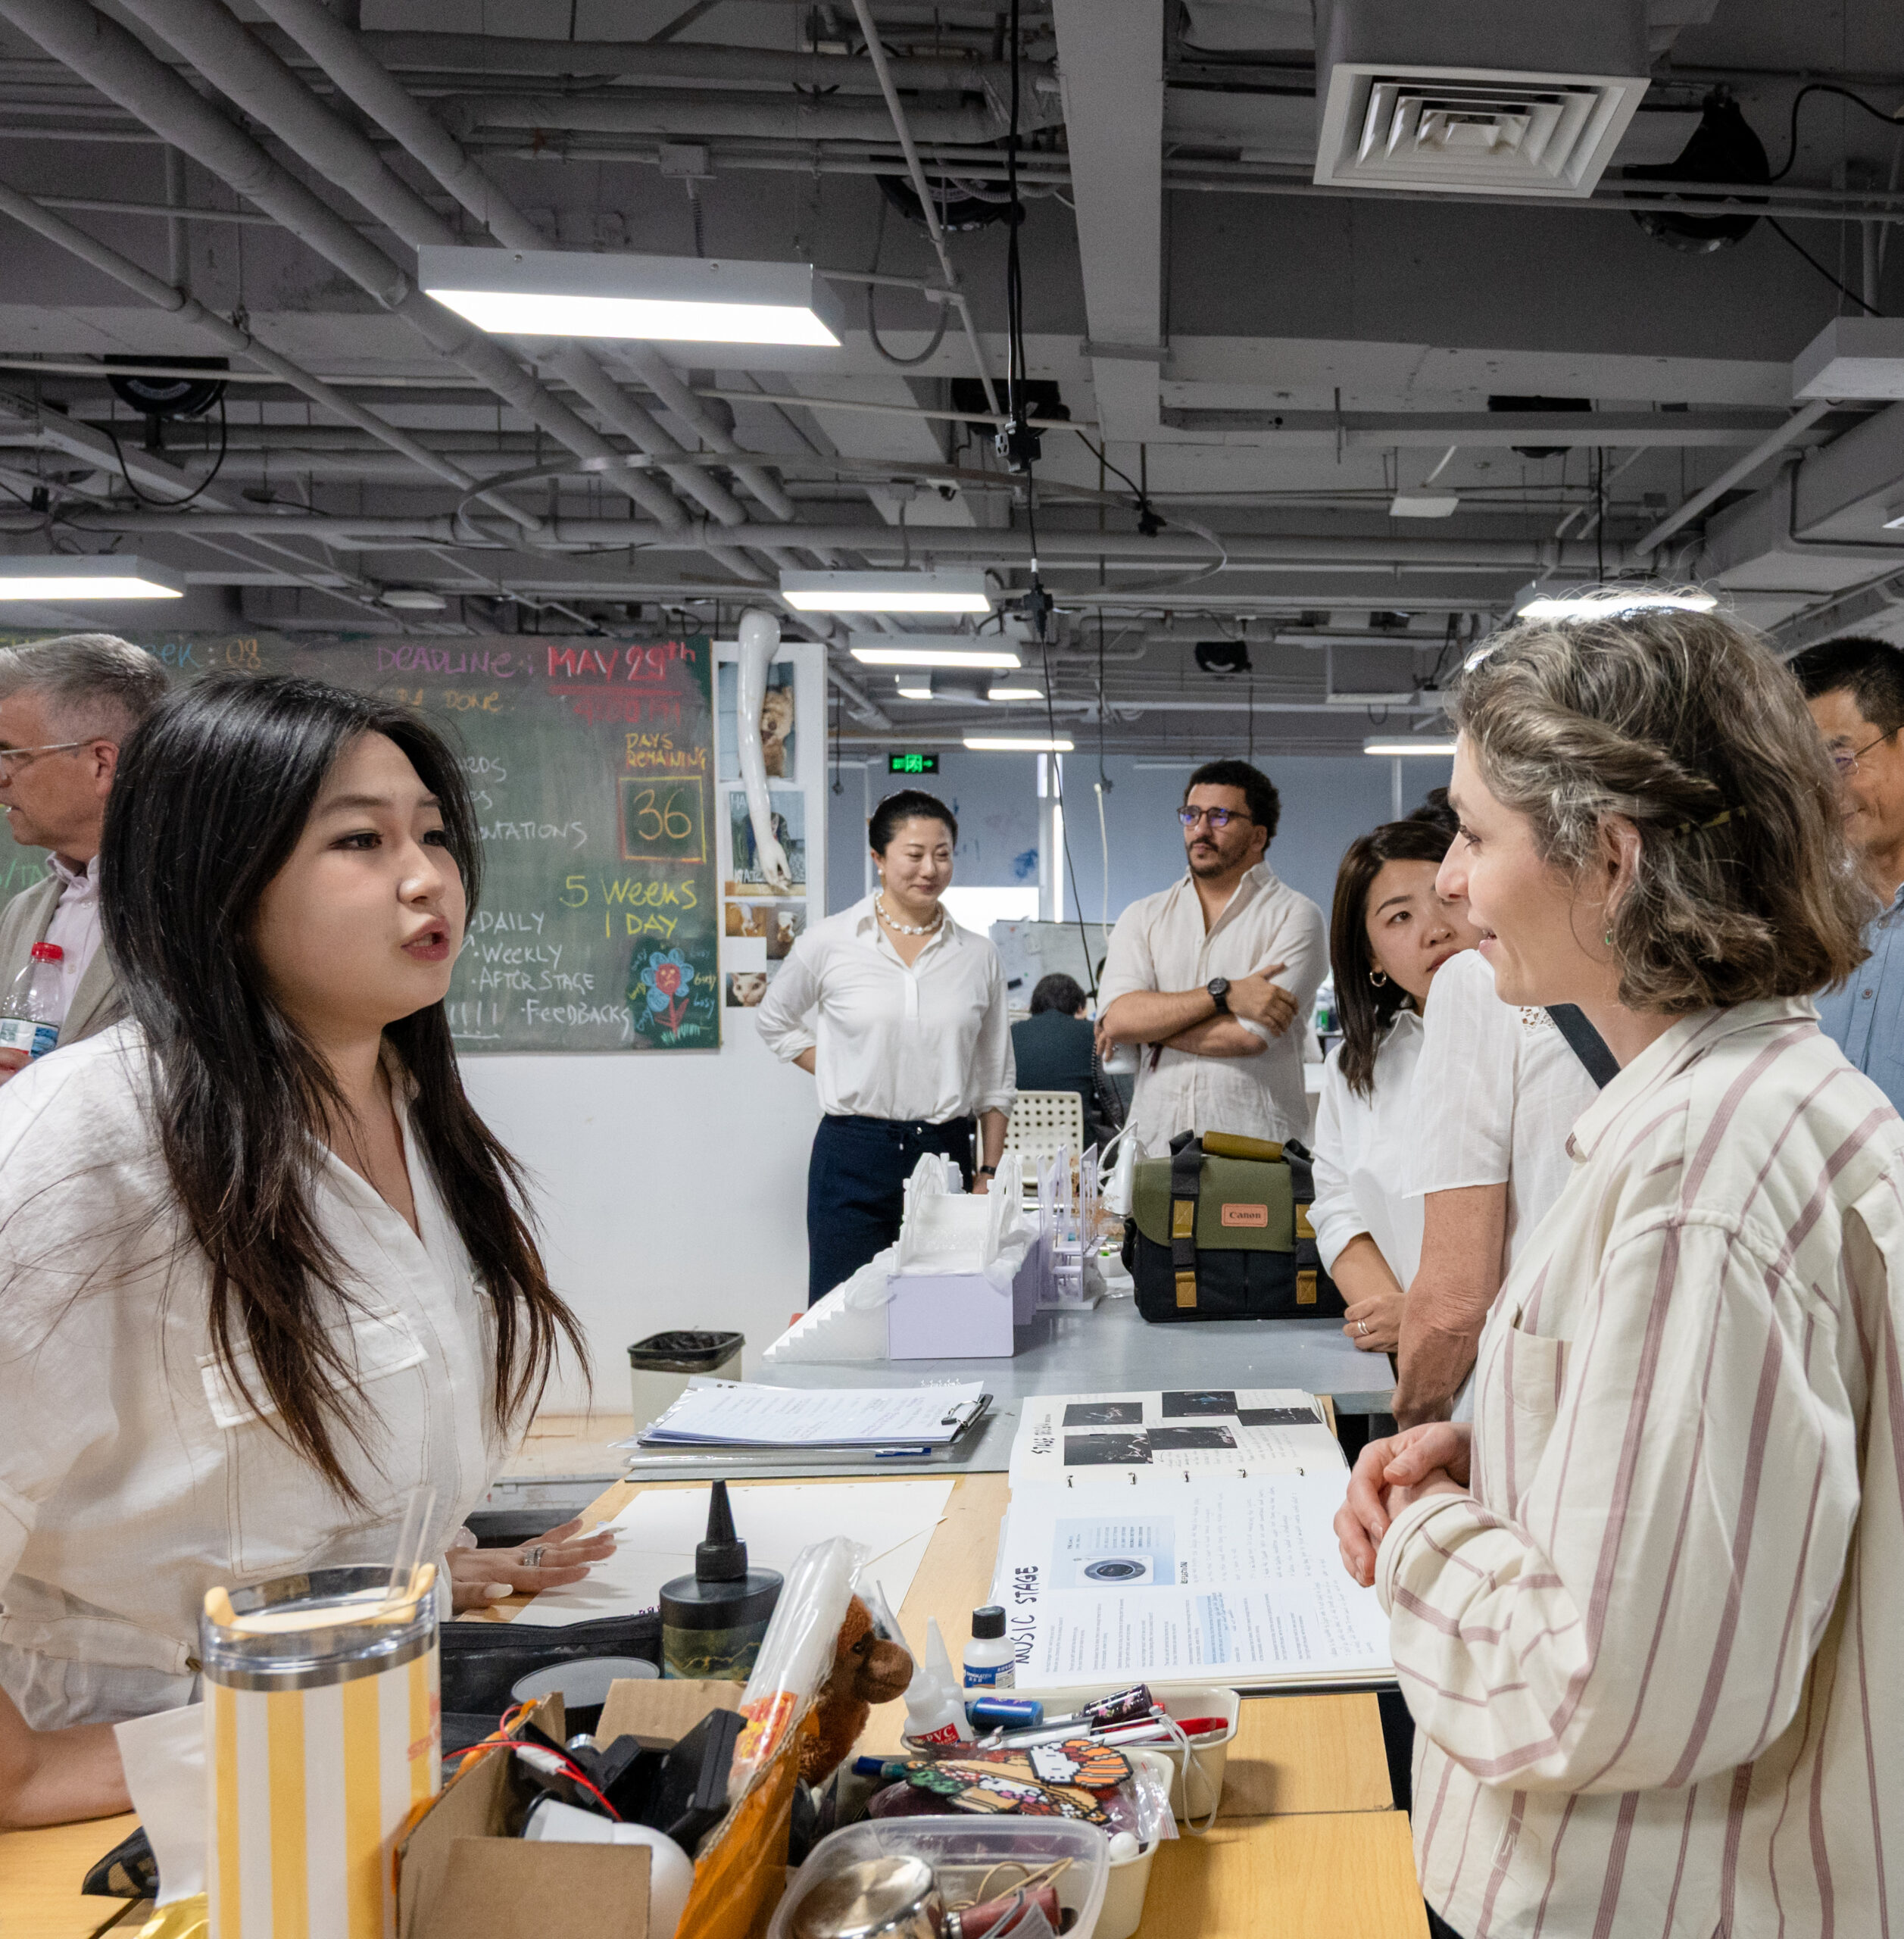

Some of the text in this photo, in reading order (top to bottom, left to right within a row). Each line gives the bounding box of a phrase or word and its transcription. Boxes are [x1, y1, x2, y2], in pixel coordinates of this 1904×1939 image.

[548, 645, 620, 682] MAY
[625, 732, 673, 750] DAYS
[633, 787, 692, 840] 36
[479, 820, 588, 849] NTATIONS
[559, 875, 589, 908] 5
[479, 910, 545, 935] DAILY
[626, 913, 679, 939] DAY
[479, 966, 595, 995] AFTER STAGE
[1010, 1565, 1041, 1664] MUSIC STAGE
[925, 1726, 953, 1742] PVC
